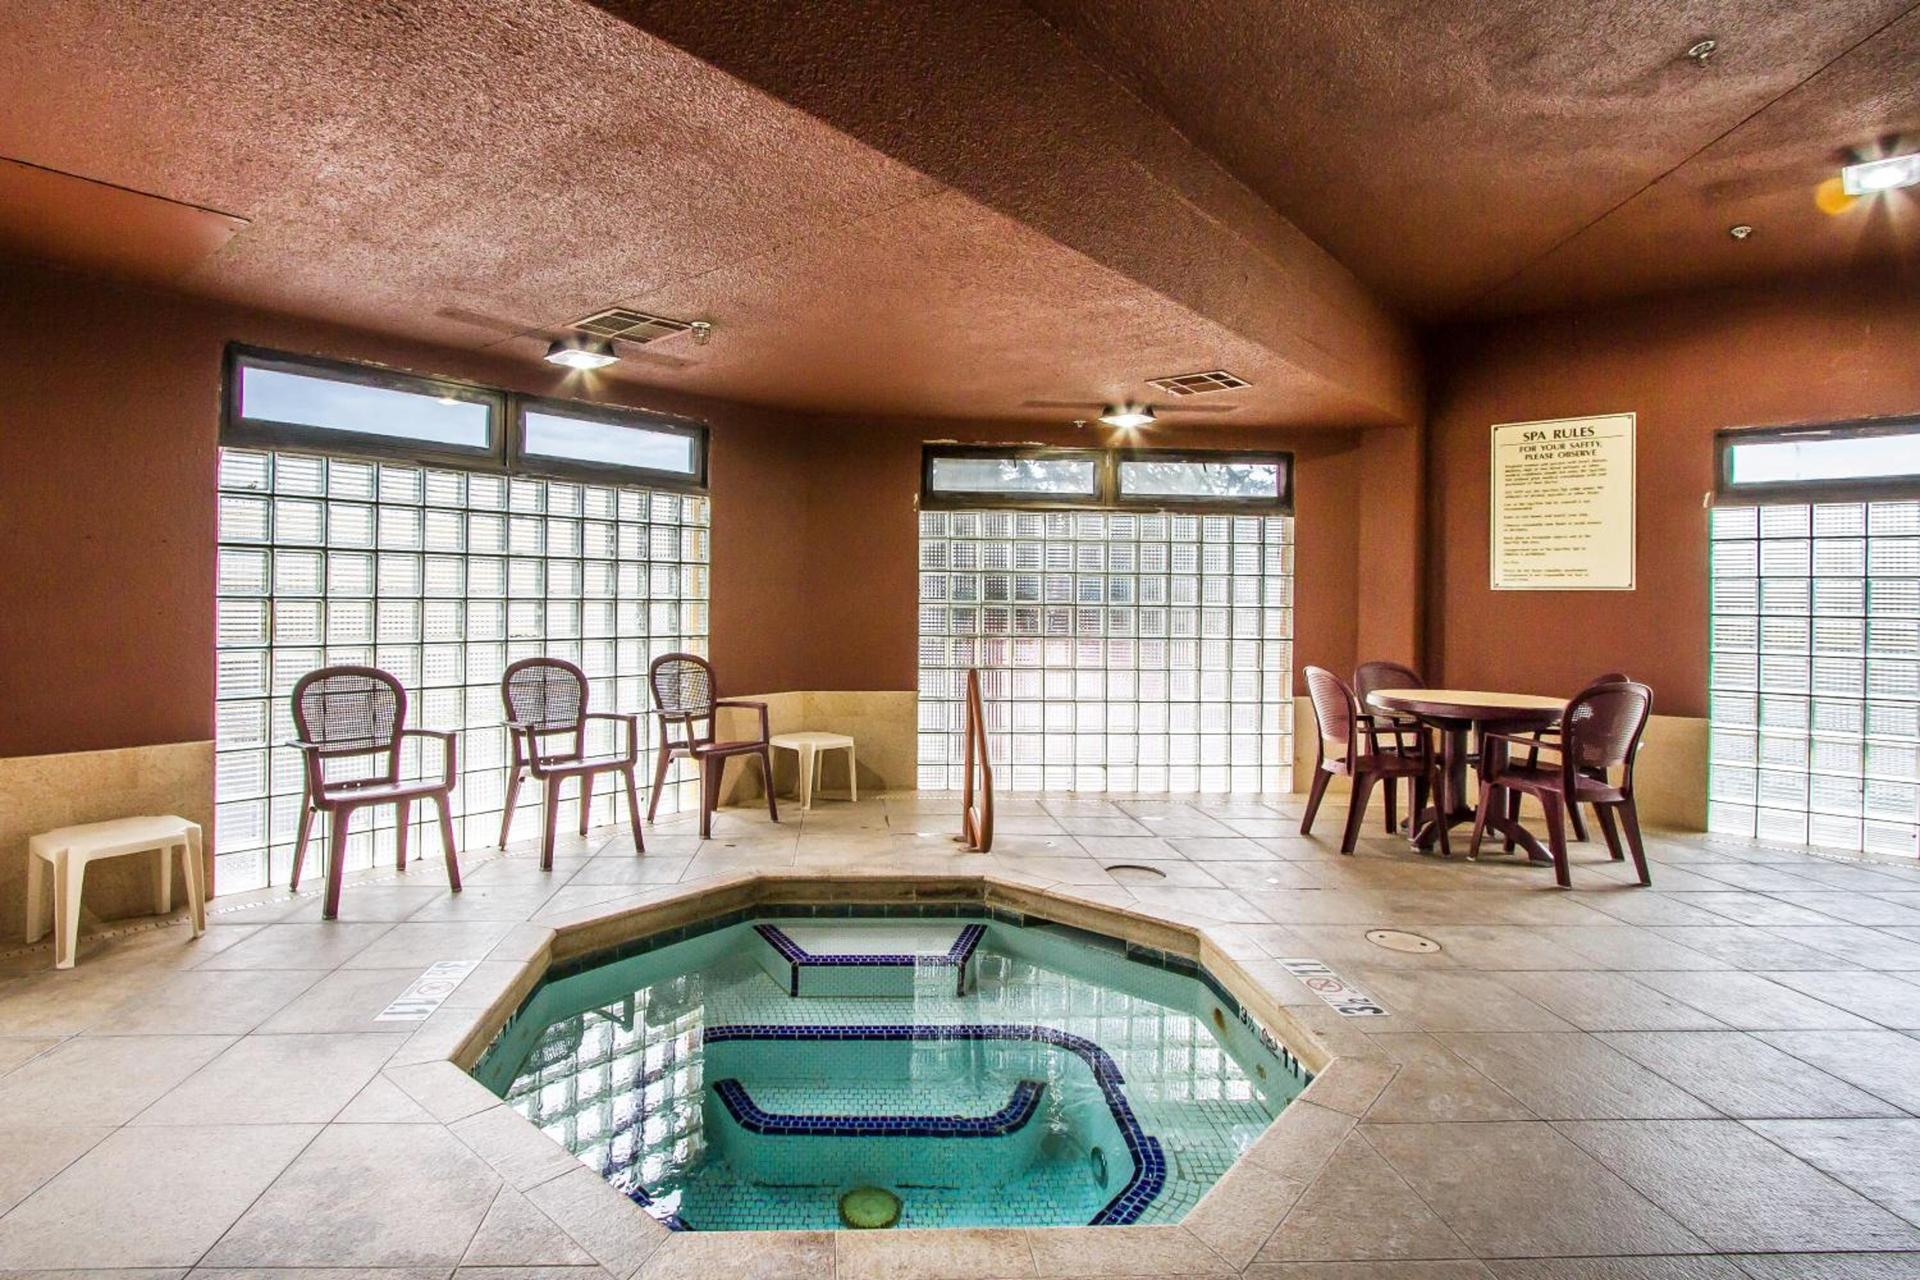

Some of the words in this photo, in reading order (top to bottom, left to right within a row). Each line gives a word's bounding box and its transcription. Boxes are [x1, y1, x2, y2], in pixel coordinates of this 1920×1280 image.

[1523, 431, 1546, 441] SPA
[1553, 426, 1595, 439] RULES
[1541, 443, 1566, 451] YOUR
[1525, 452, 1553, 460] PLEASE
[1558, 449, 1597, 458] OBSERVE
